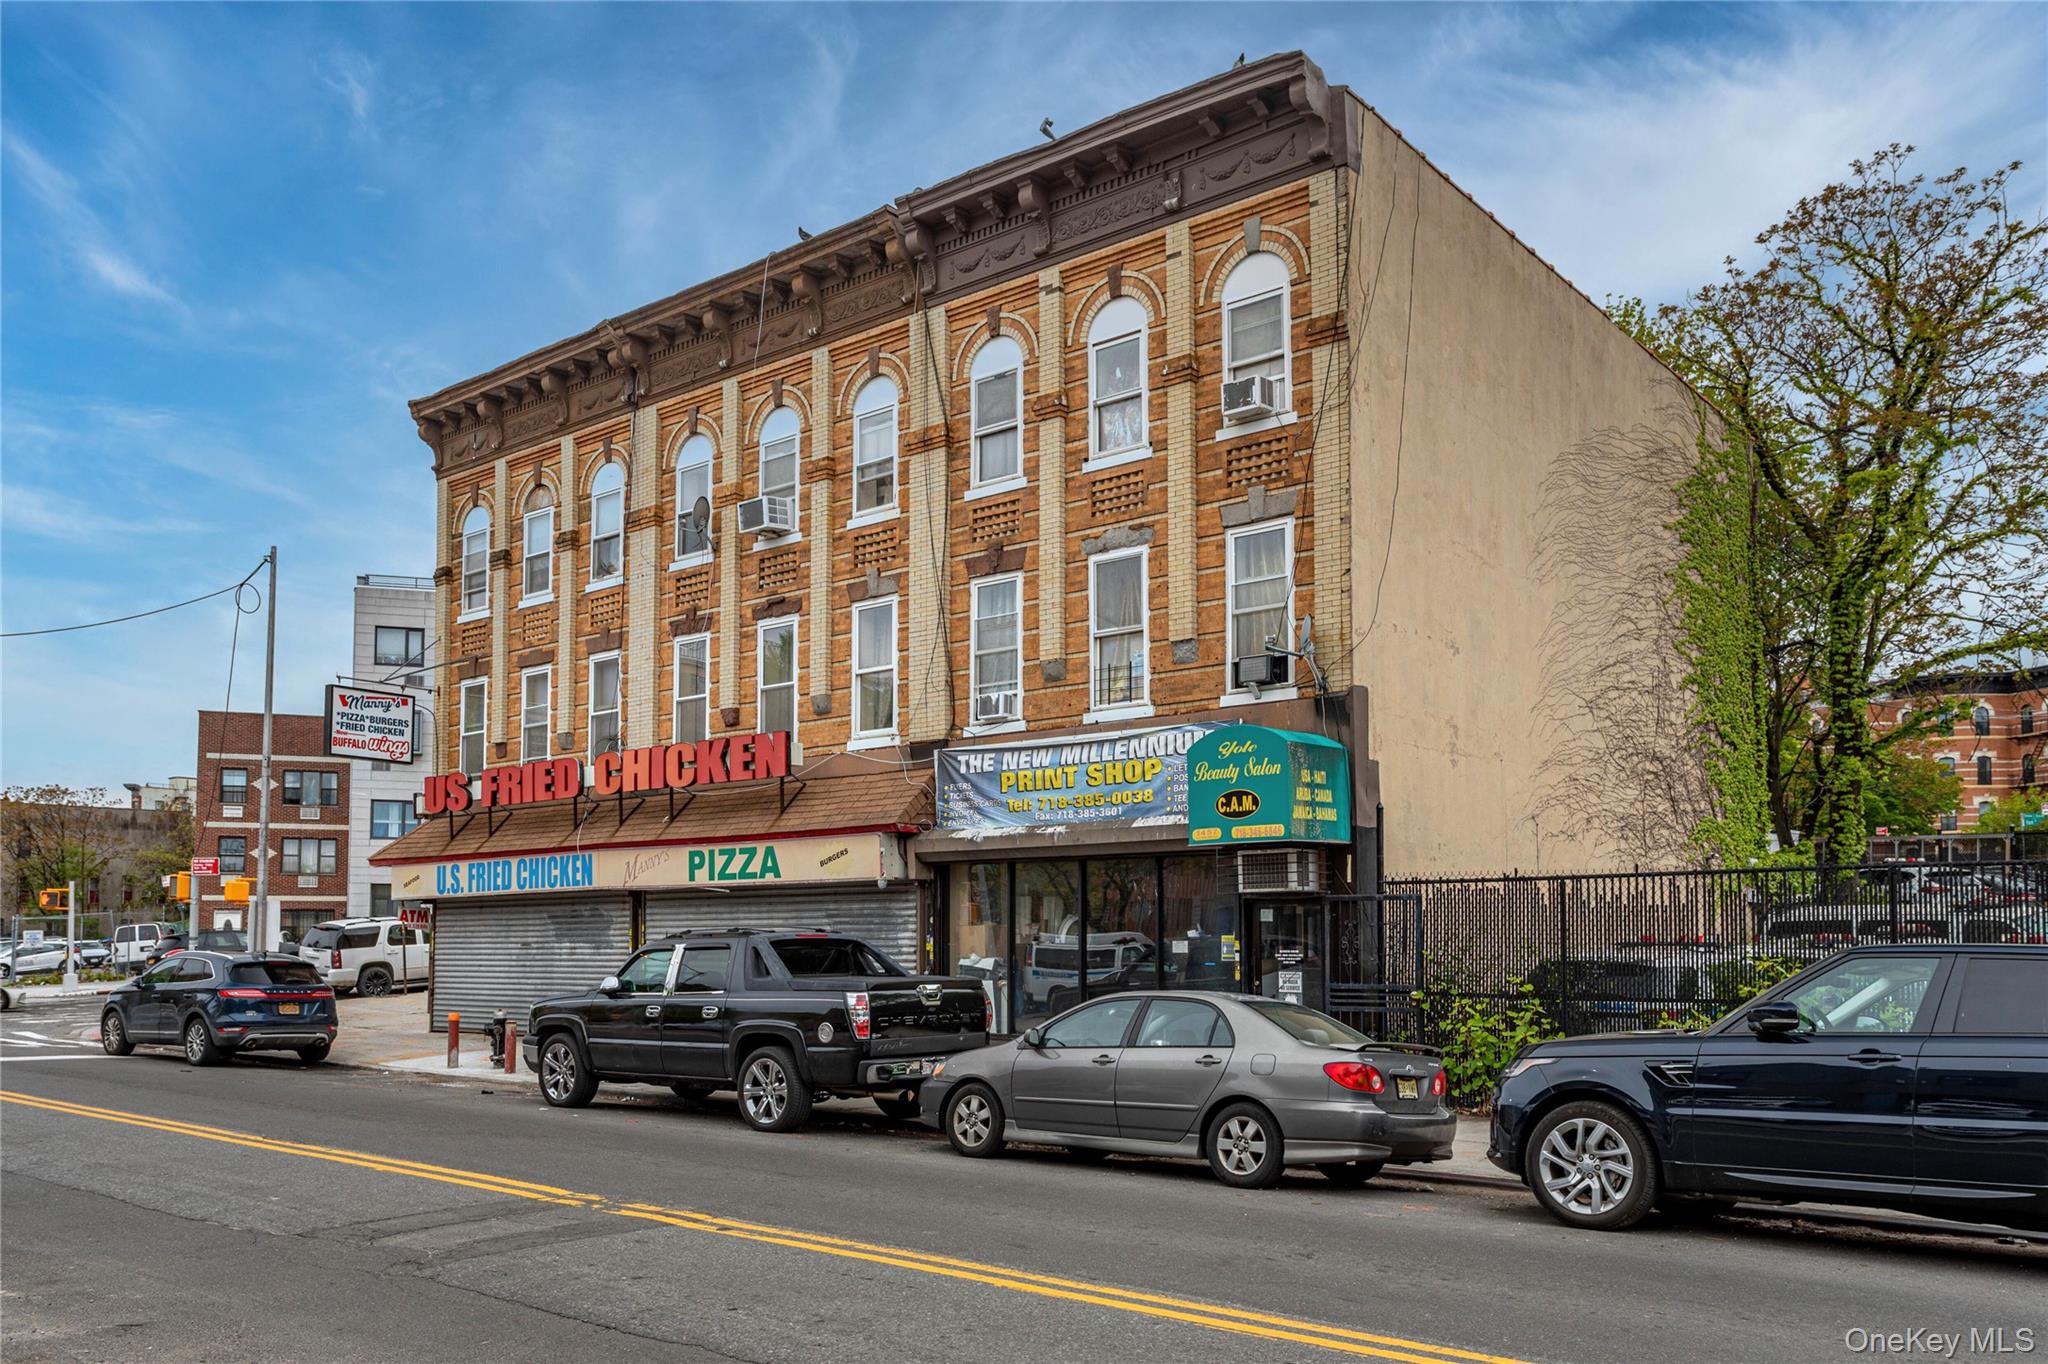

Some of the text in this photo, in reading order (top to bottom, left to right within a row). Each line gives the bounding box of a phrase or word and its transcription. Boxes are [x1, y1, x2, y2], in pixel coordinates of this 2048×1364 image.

[347, 695, 401, 713] Manny's
[340, 722, 405, 737] FRIED CHICKEN
[369, 715, 409, 728] BURGERS
[332, 735, 410, 760] BUFFALO wings
[424, 730, 792, 814] US FRIED CHICKEN
[957, 752, 995, 775] THE
[1002, 749, 1051, 771] NEW
[1193, 755, 1281, 785] Beauty Salon
[1001, 758, 1163, 794] PRINT SHOP
[949, 783, 972, 791] FLYERS
[949, 791, 974, 800] TICKETS
[1008, 789, 1154, 813] Tel: 718-385-0038
[1217, 795, 1257, 814] C.A.M.
[1035, 806, 1123, 821] Fax: 718-385-3601
[688, 845, 782, 882] PIZZA
[819, 847, 849, 868] BURGERS
[436, 853, 593, 896] U.S. FRIED CHICKEN
[400, 909, 429, 923] ATM
